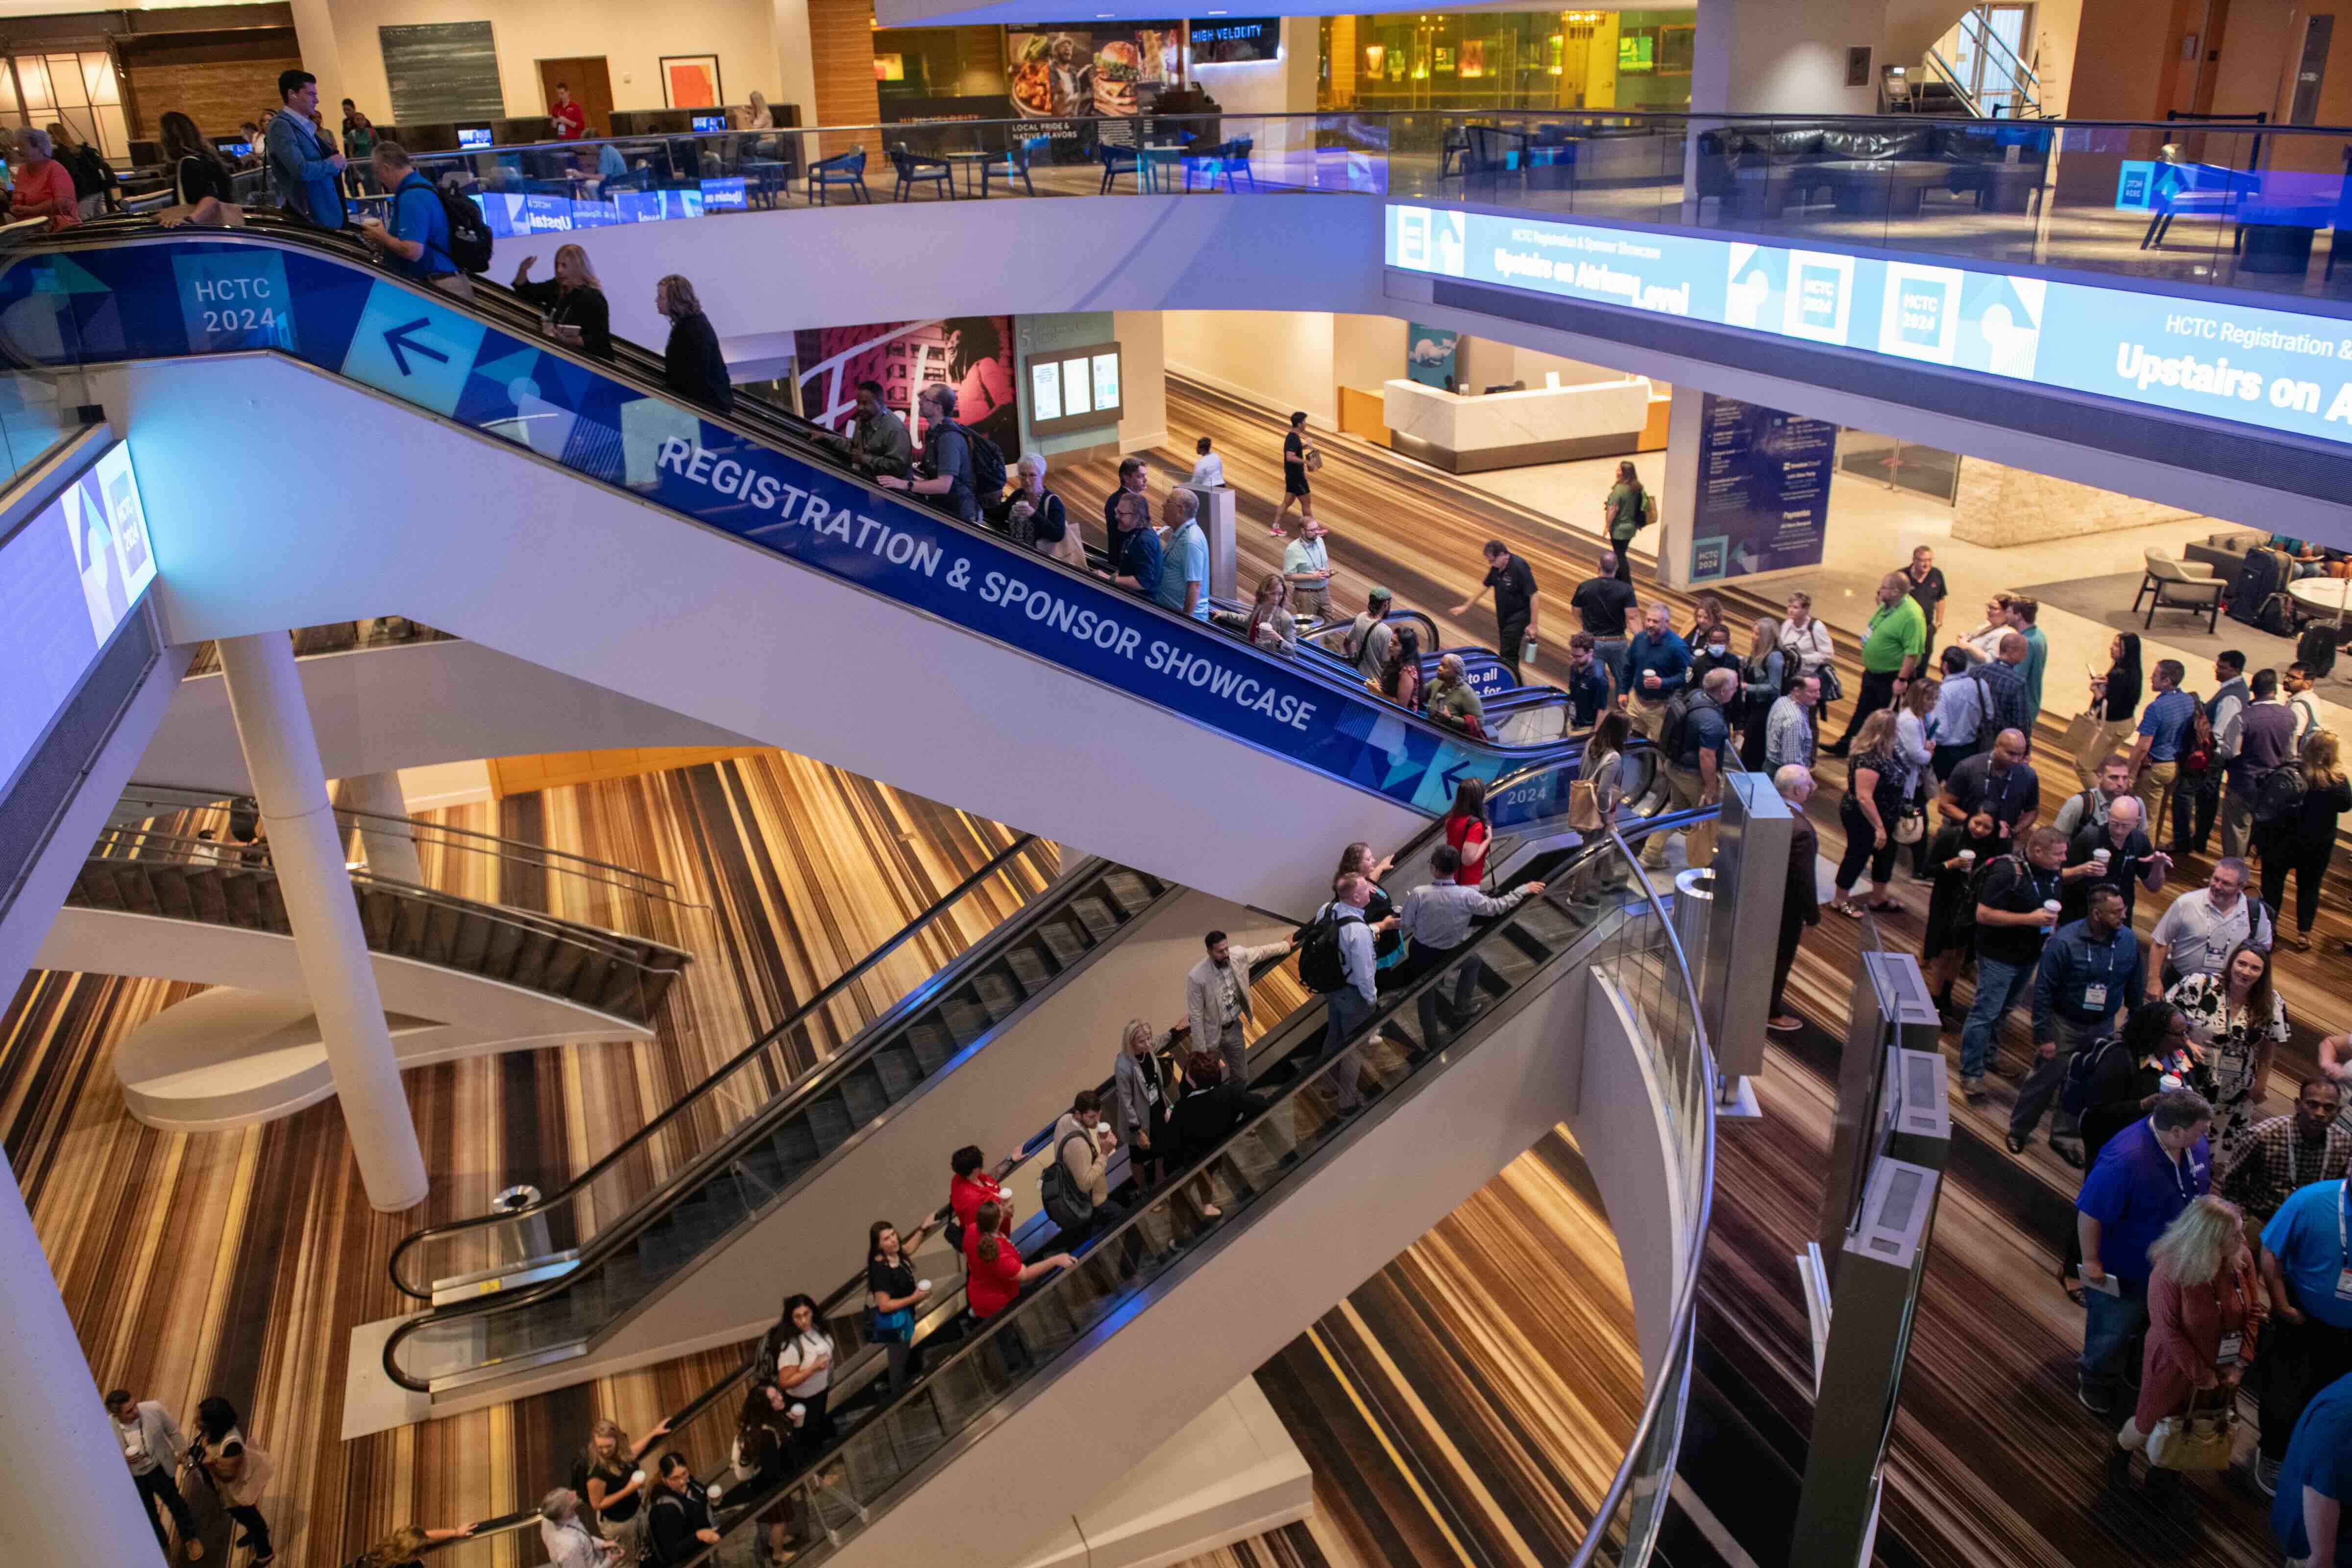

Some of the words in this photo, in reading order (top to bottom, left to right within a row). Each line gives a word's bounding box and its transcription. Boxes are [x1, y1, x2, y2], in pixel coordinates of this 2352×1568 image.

[1191, 30, 1215, 42] HIGH
[1216, 24, 1263, 40] VELOCITY
[1011, 123, 1038, 132] LOCAL
[1064, 122, 1070, 131] &
[195, 278, 271, 302] HCTC
[1494, 247, 1553, 278] Upstairs
[1554, 260, 1574, 283] on
[1631, 282, 1690, 315] Level
[1803, 278, 1835, 297] HCTC
[1903, 294, 1938, 312] HCTC
[203, 307, 276, 332] 2024
[1903, 311, 1936, 331] 2024
[2165, 314, 2217, 339] HCTC
[2220, 321, 2334, 357] Registration
[2116, 342, 2263, 401] Upstairs
[2269, 377, 2321, 414] on
[1698, 549, 1719, 560] HCTC
[1698, 560, 1717, 569] 2024
[659, 433, 943, 576] REGISTRATION
[946, 558, 971, 591] &
[980, 571, 1141, 660] SPONSOR
[1145, 639, 1317, 731] SHOWCASE
[1468, 673, 1480, 685] to
[1483, 667, 1498, 682] all
[1507, 786, 1547, 805] 2024
